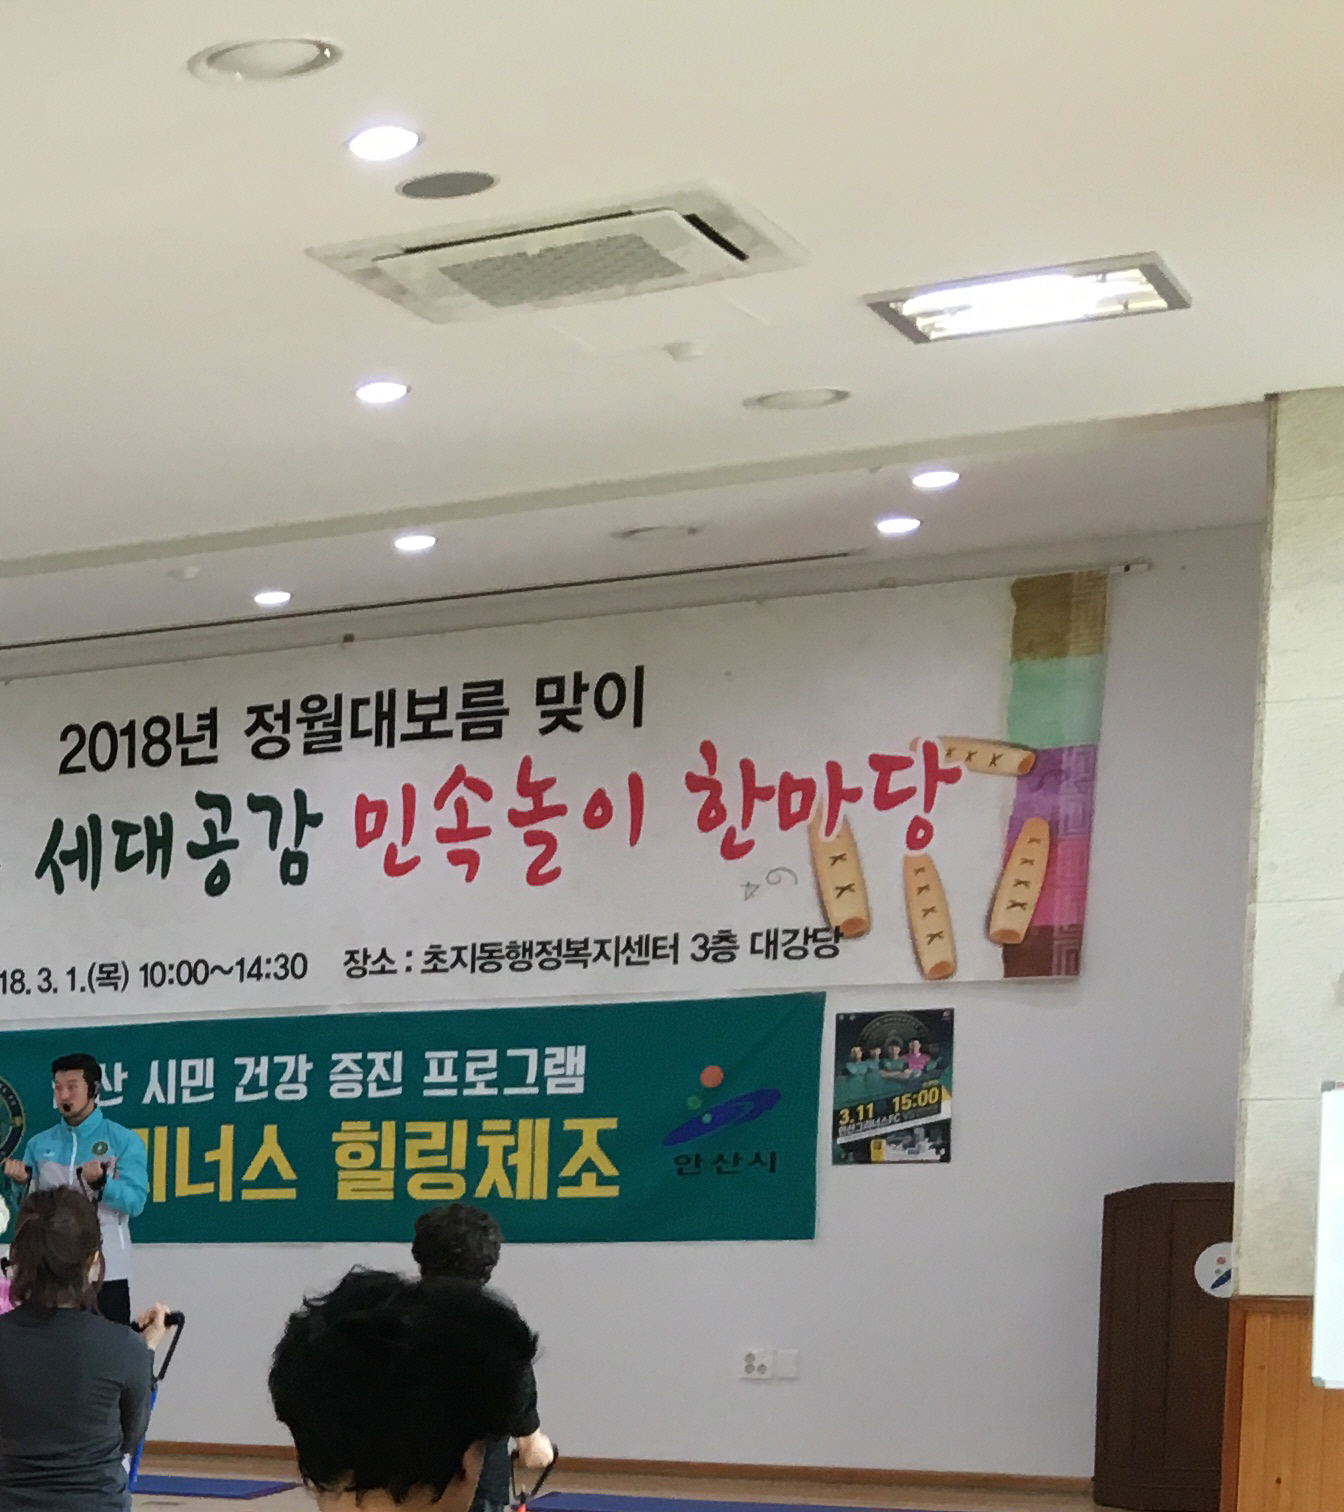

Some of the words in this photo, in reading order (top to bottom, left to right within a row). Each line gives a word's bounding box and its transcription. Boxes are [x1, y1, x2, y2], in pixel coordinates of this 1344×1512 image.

[59, 706, 218, 775] 2018년
[244, 679, 510, 760] 정월대보름
[536, 665, 644, 736] 맞이
[35, 789, 323, 897] 세대공감
[355, 757, 643, 886] 민속놀이
[686, 741, 961, 860] 한마당
[139, 953, 307, 987] 10:00~14:30
[421, 933, 679, 973] 초지동행정복지센터
[691, 930, 739, 963] 3층
[749, 926, 844, 962] 대강당
[143, 1058, 213, 1104] 시민
[235, 1054, 312, 1101] 건강
[330, 1051, 402, 1098] 증진
[424, 1046, 585, 1096] 프로그램
[839, 1103, 874, 1125] 3.11
[892, 1086, 939, 1112] 15:00
[333, 1118, 619, 1201] 힐링체조
[673, 1151, 777, 1175] 안산시
